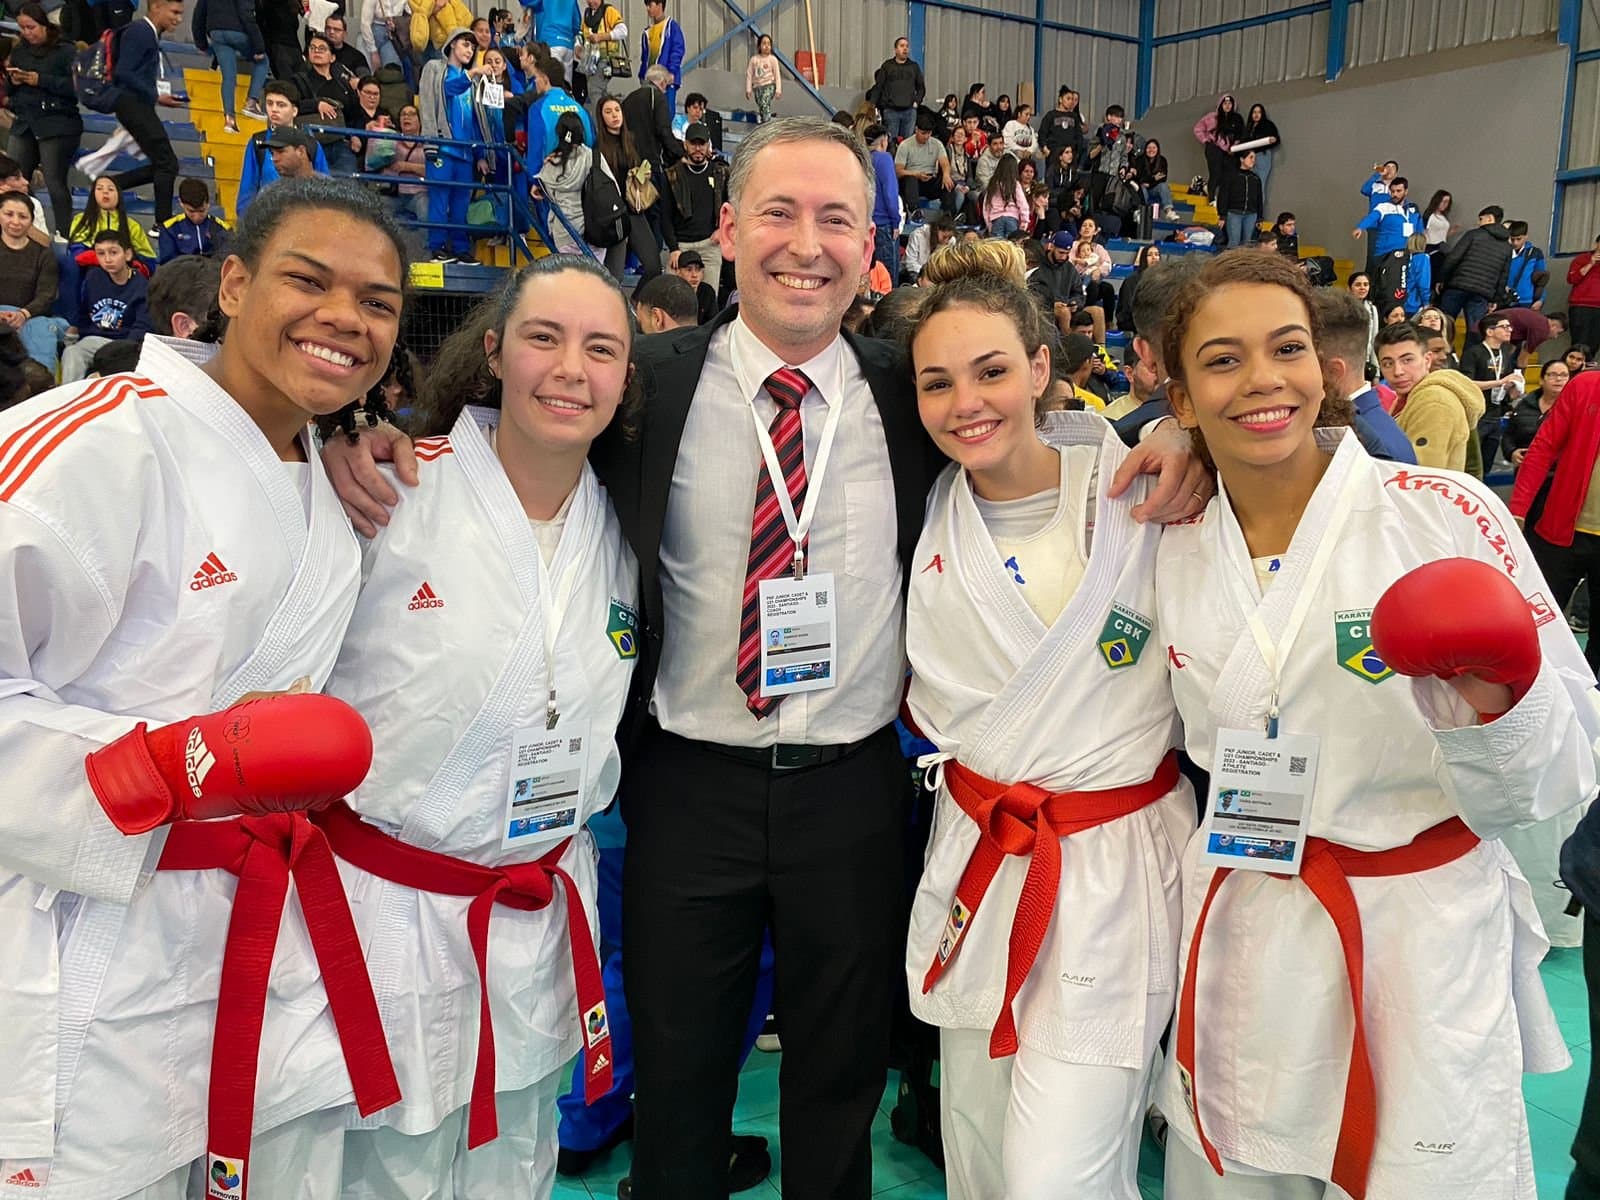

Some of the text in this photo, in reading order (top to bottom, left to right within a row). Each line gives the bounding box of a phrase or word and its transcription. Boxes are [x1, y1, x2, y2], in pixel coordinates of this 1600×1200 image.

[191, 572, 238, 591] adidas
[408, 599, 444, 610] adidas
[1114, 619, 1143, 641] CBK
[186, 726, 202, 798] adidas
